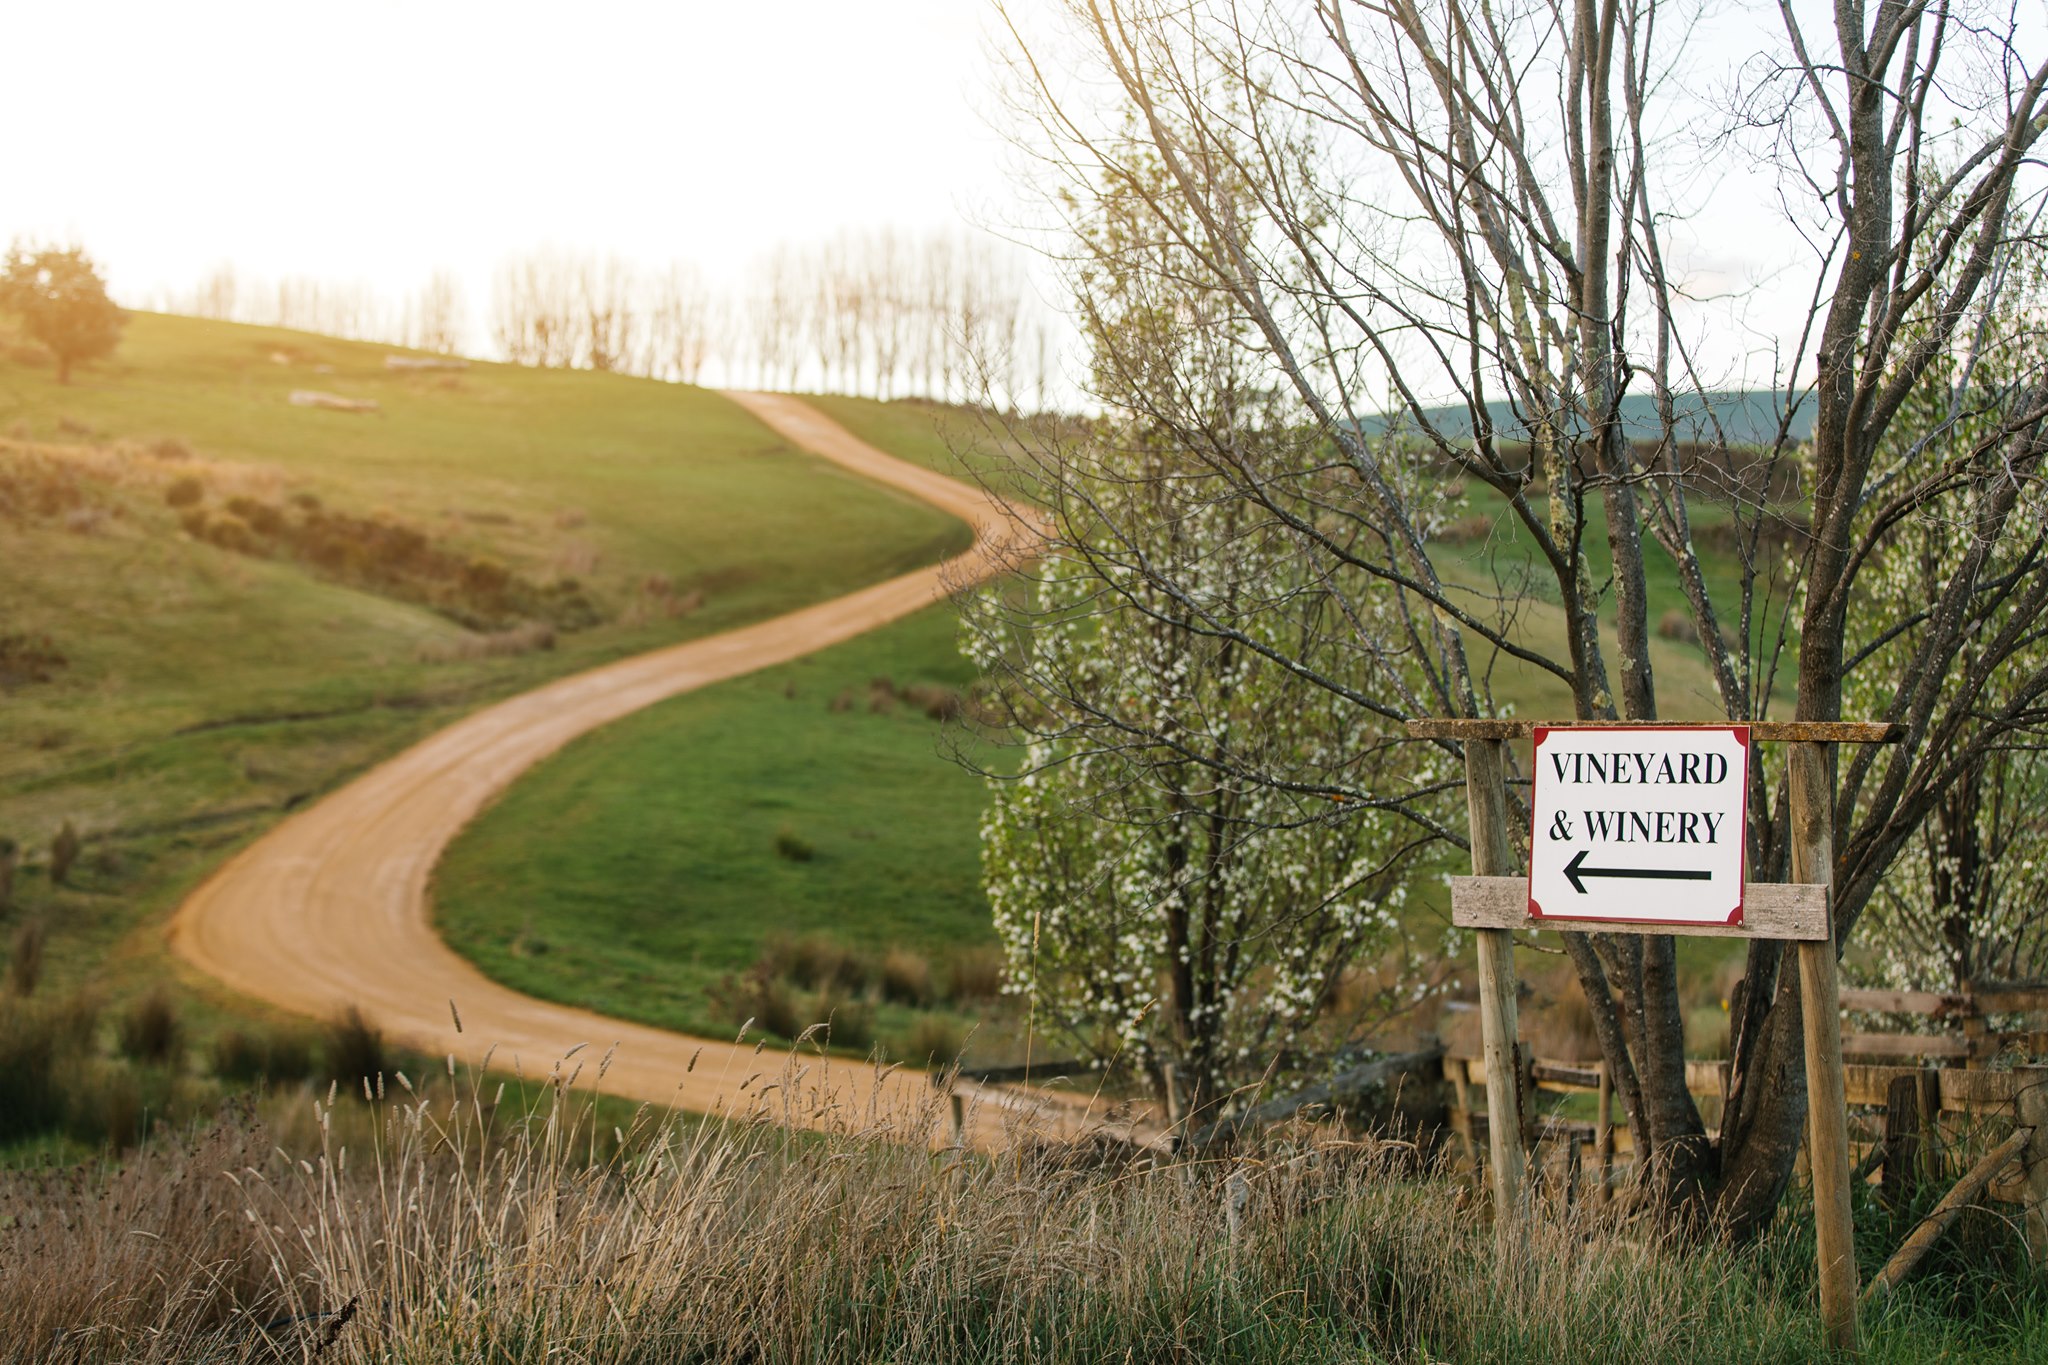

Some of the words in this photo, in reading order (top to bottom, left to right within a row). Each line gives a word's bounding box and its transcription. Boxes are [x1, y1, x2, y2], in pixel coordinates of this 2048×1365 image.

[1550, 752, 1728, 784] VINEYARD
[1549, 809, 1574, 841] &
[1583, 810, 1725, 844] WINERY
